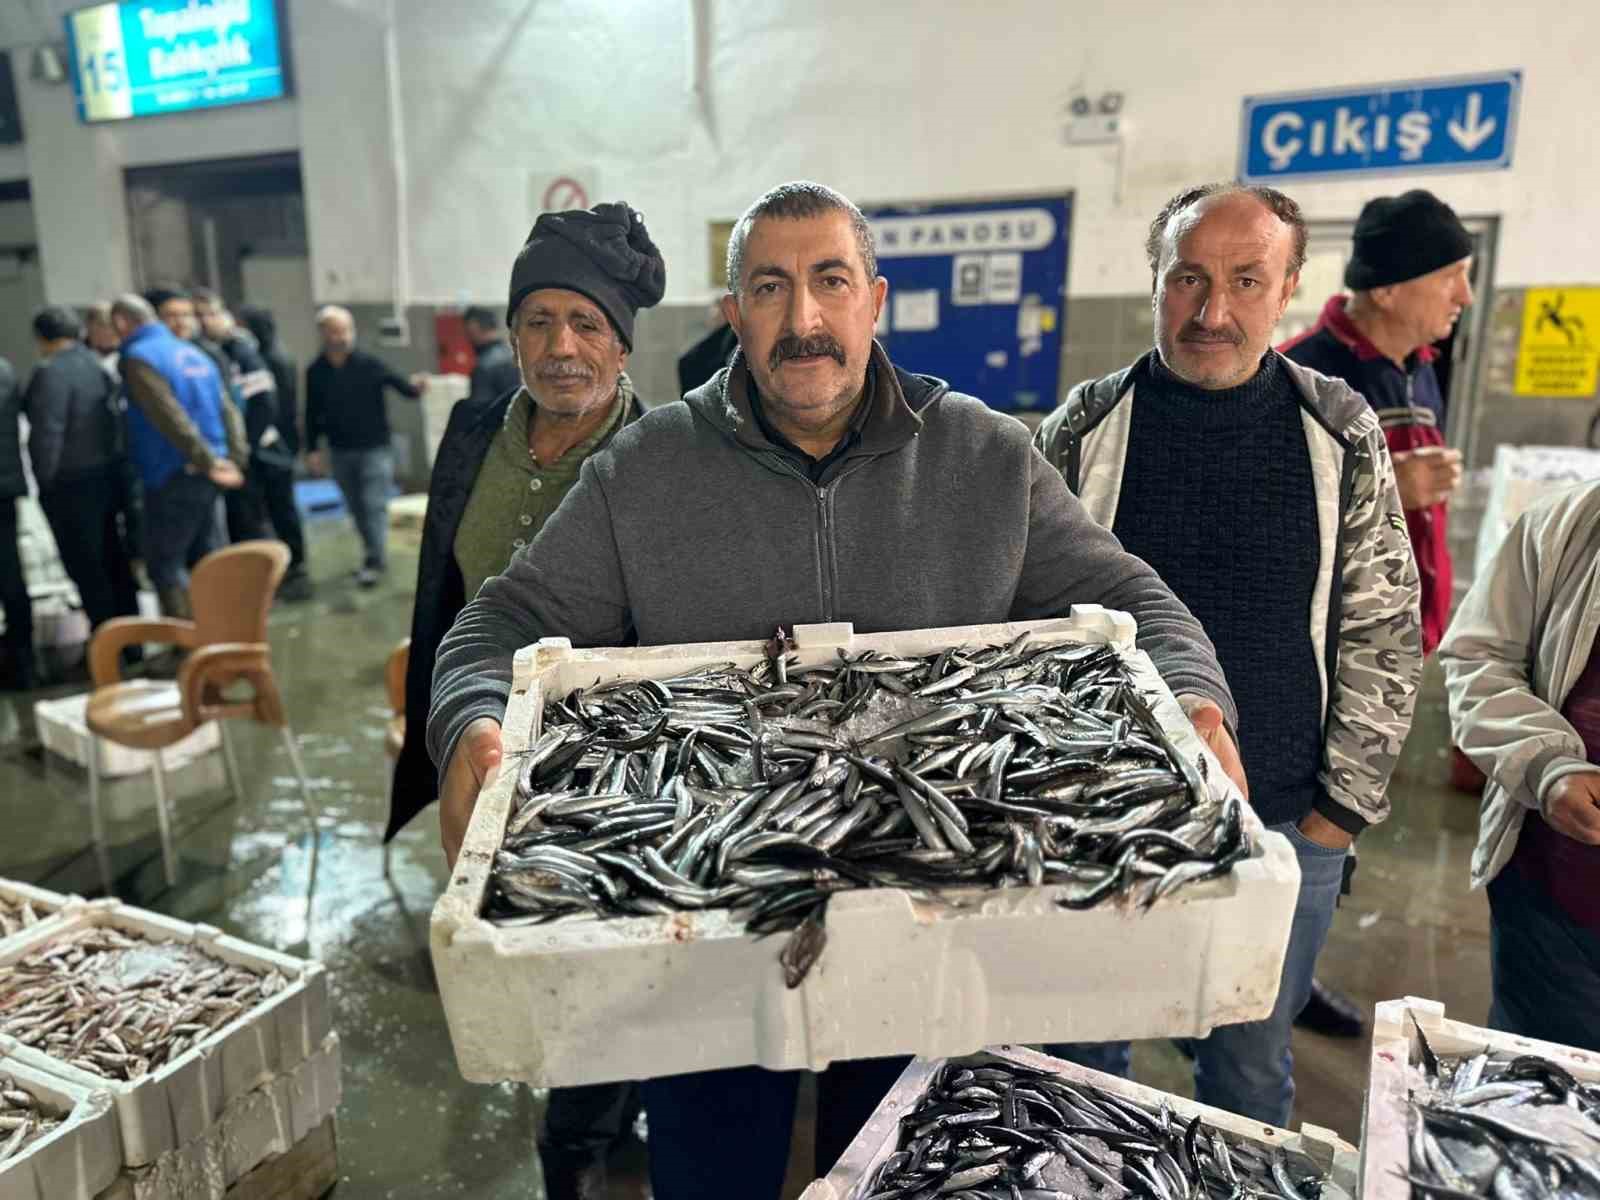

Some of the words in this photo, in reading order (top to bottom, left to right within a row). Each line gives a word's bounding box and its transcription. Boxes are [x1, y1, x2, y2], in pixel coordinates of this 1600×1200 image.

[85, 51, 123, 93] 15
[1262, 107, 1432, 170] Çıkış
[911, 220, 1037, 243] PANOSU
